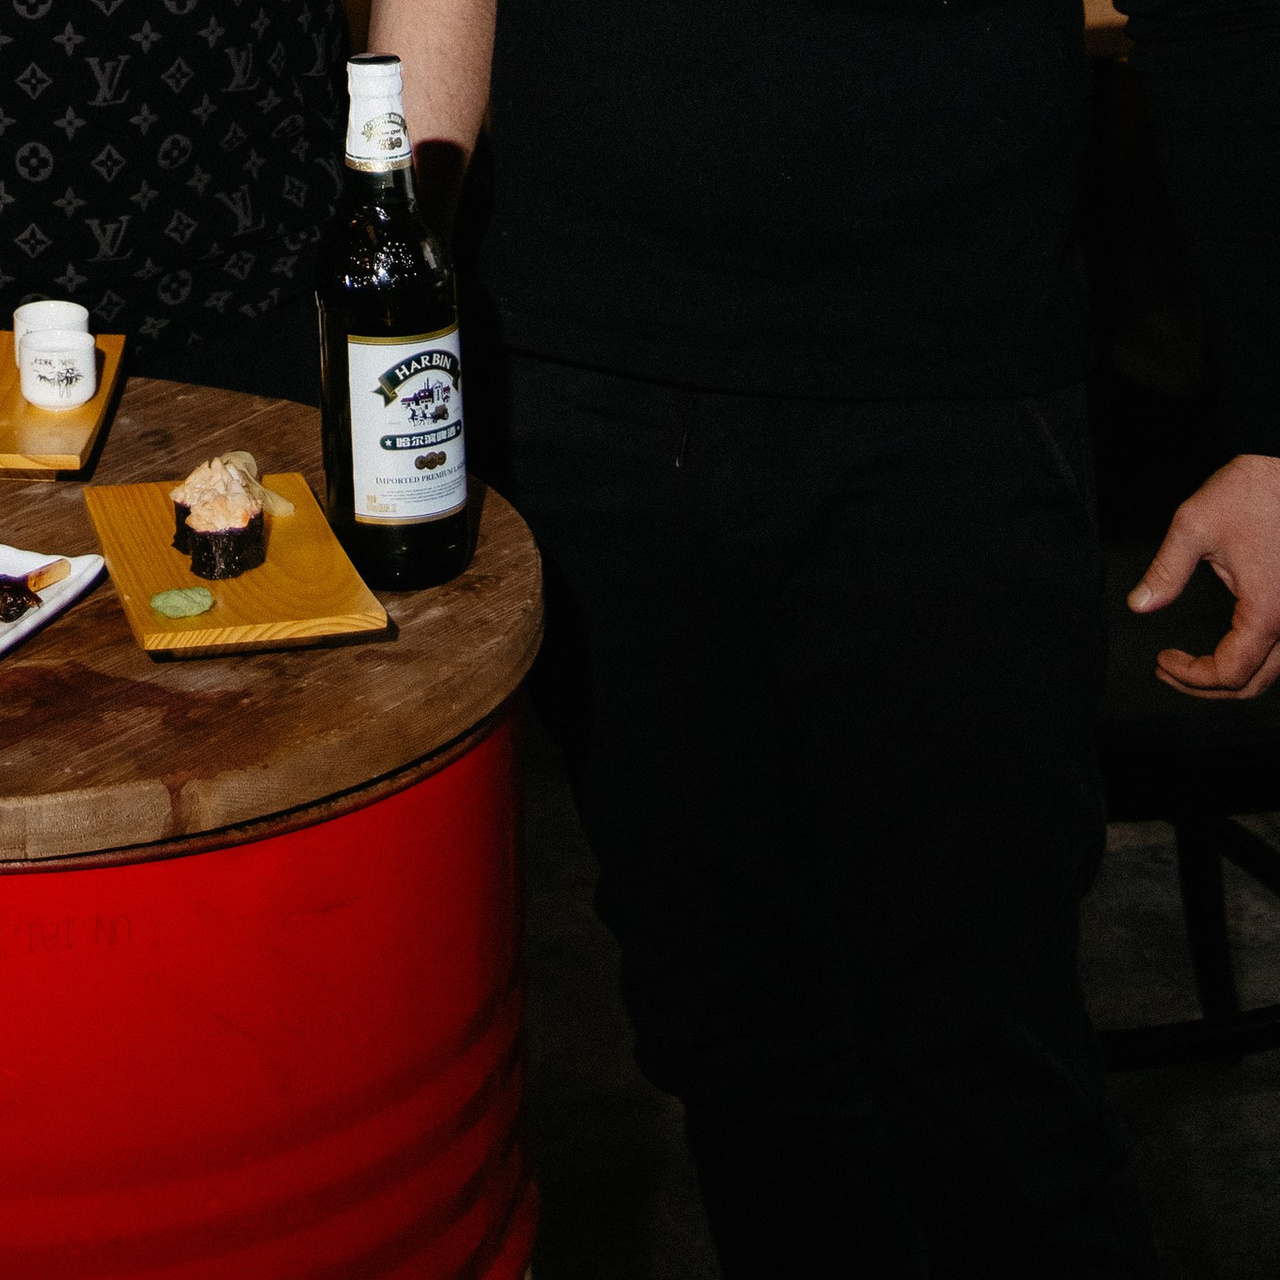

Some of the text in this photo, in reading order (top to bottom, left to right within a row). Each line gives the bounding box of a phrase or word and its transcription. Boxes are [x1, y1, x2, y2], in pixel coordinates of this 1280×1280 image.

[395, 353, 452, 381] HARBIN
[375, 476, 421, 484] IMPORTED
[421, 467, 453, 482] PREMIUM
